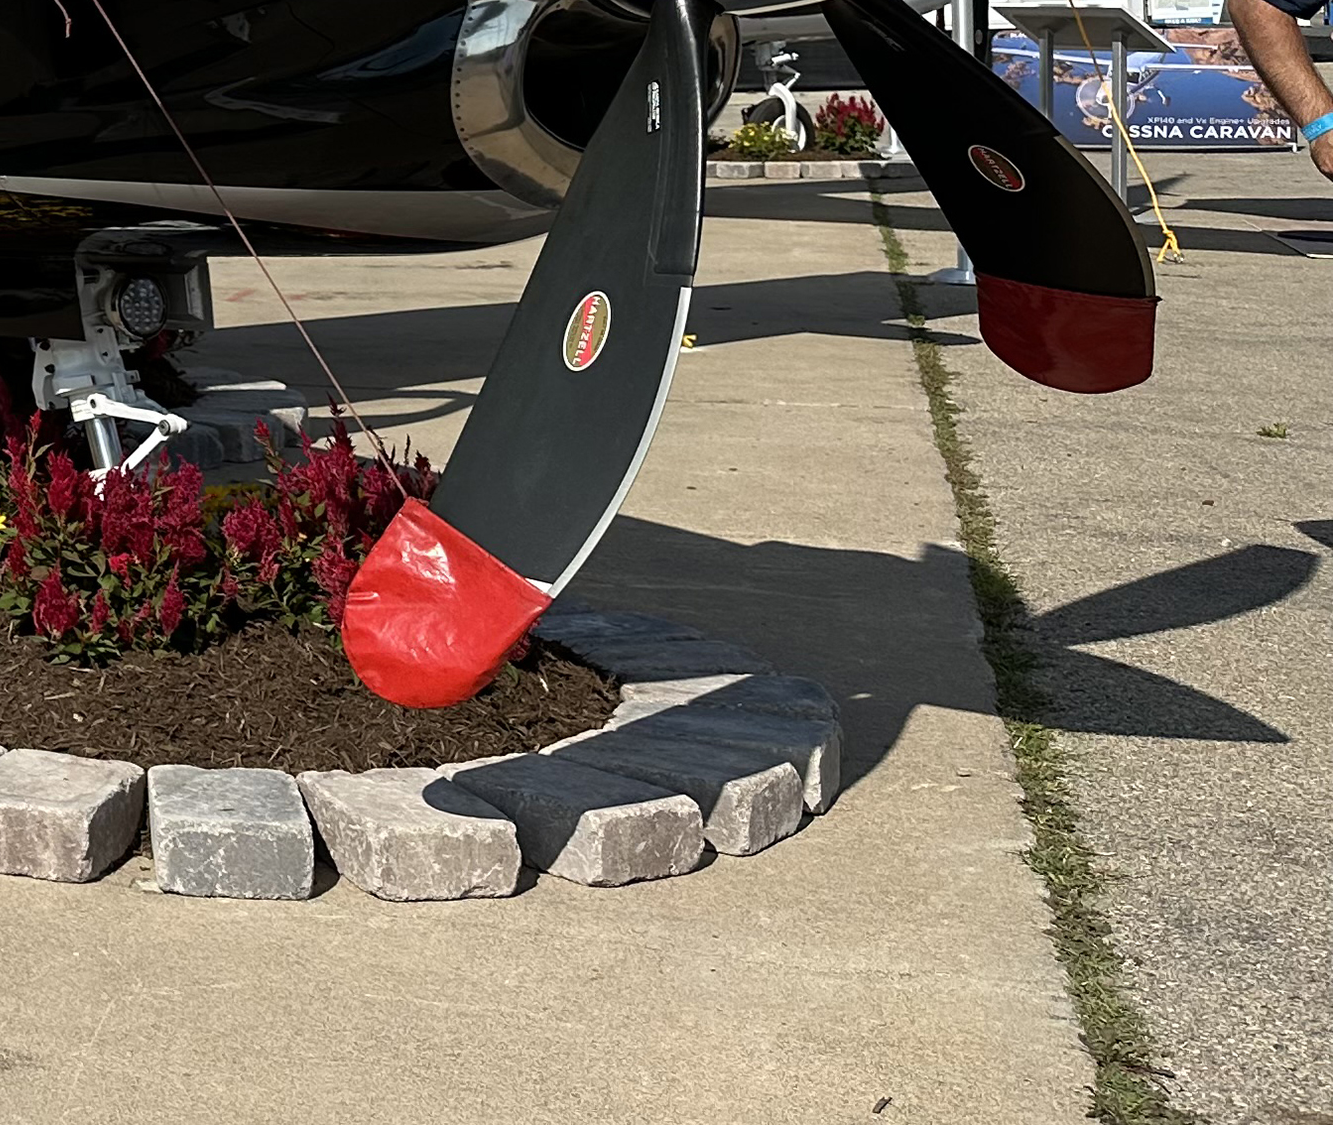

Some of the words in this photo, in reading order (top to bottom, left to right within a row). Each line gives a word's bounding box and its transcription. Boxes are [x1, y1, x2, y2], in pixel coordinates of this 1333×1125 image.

[1102, 125, 1184, 139] CSSNA
[1189, 125, 1292, 139] CARAVAN
[572, 296, 602, 365] HARTZELL
